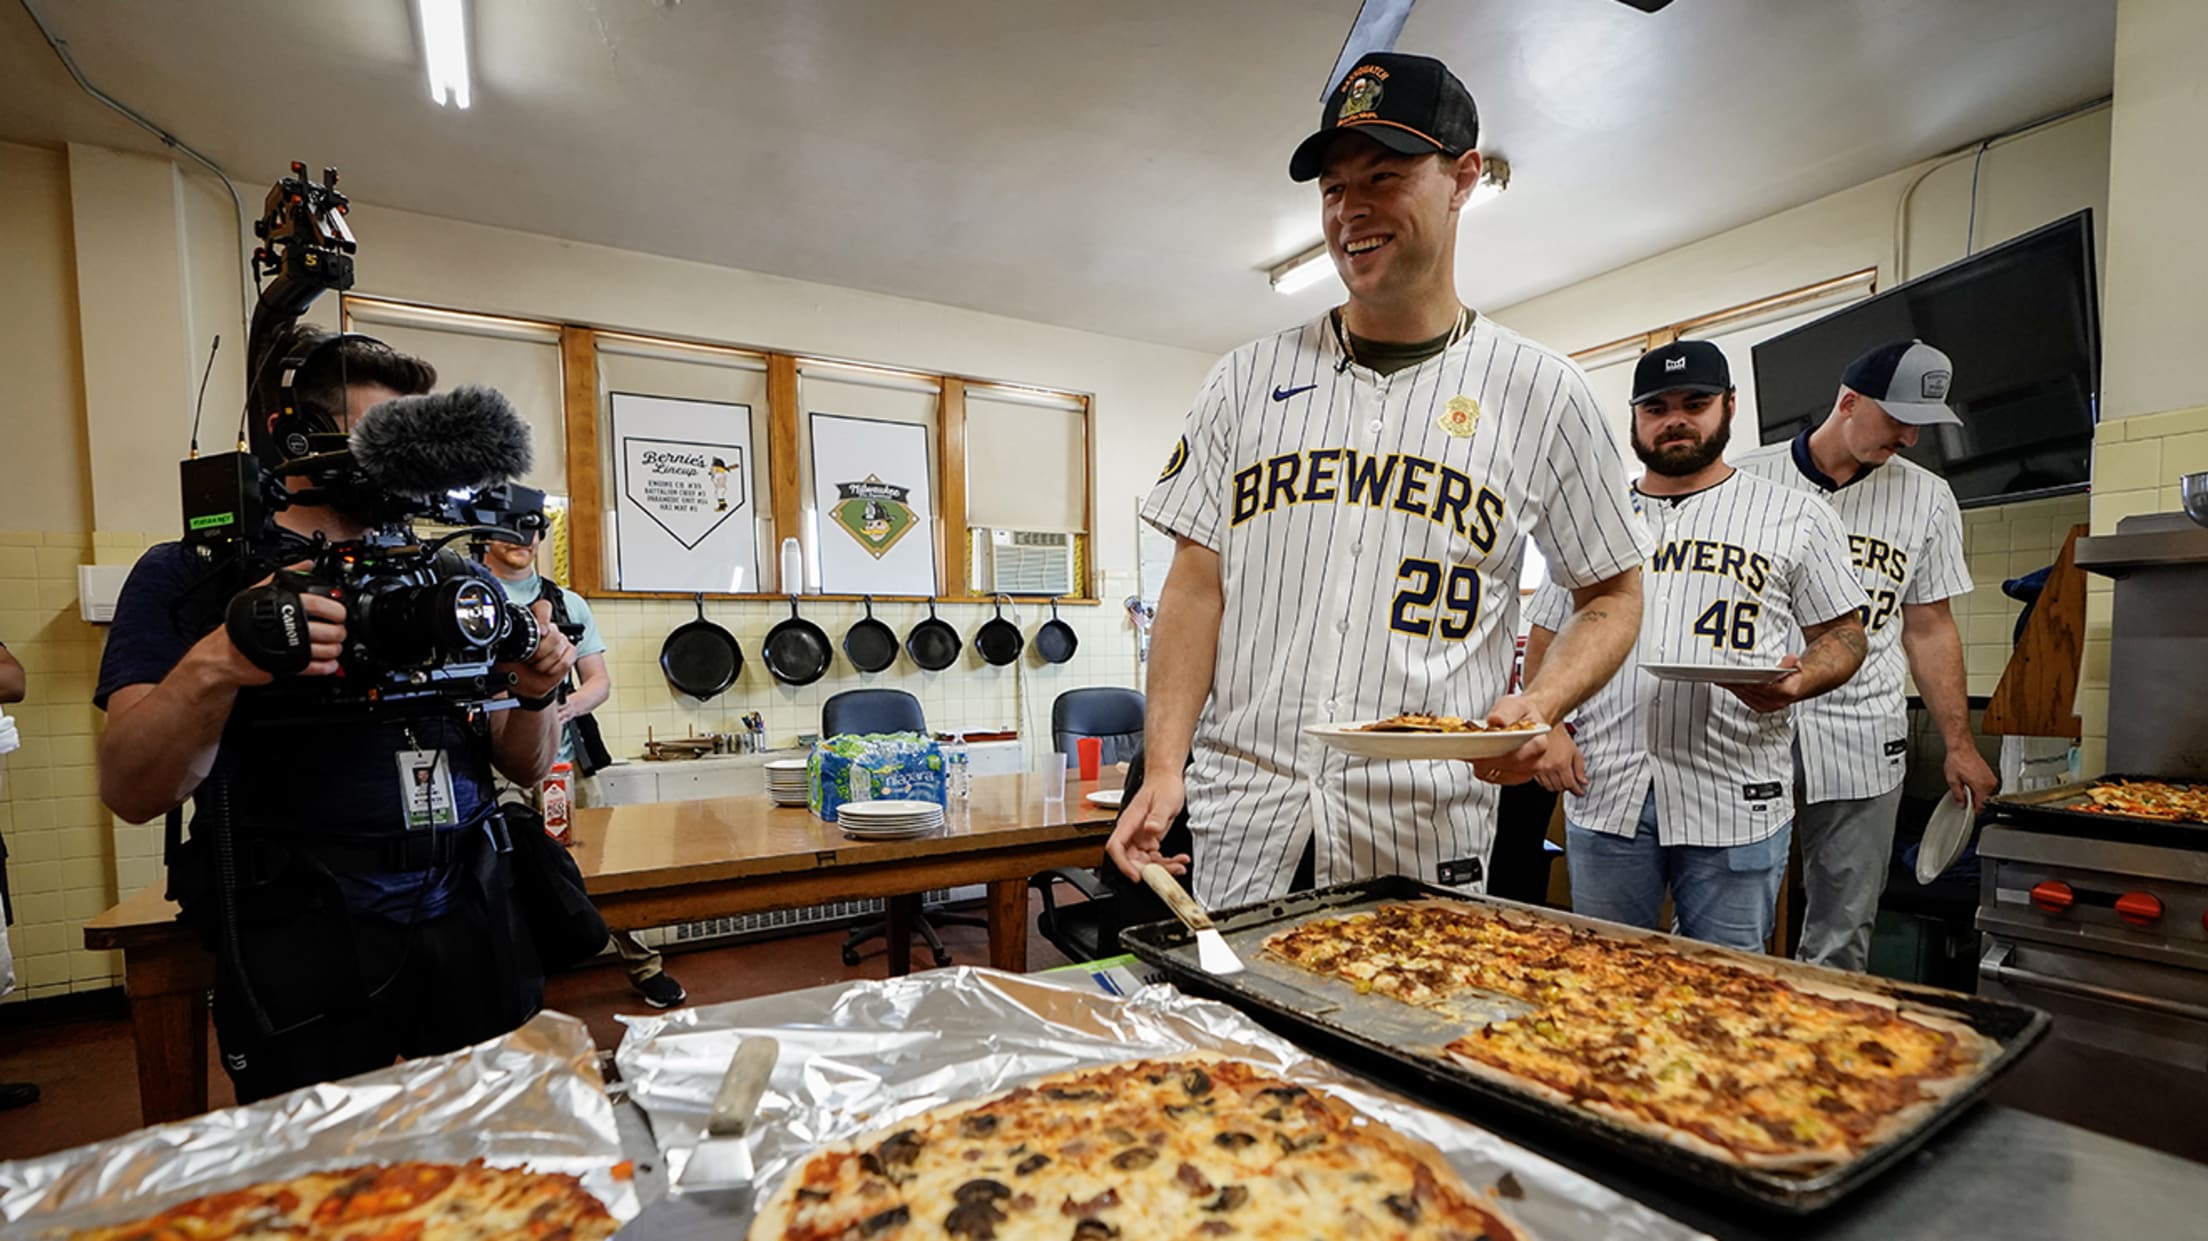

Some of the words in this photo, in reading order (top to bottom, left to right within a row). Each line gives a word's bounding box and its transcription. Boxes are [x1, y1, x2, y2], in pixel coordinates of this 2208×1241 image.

[642, 451, 706, 468] Bernie's
[652, 464, 698, 477] Lineup
[1230, 448, 1504, 557] BREWERS
[1387, 557, 1481, 642] 29
[281, 604, 300, 647] Canon
[1692, 598, 1761, 652] 46
